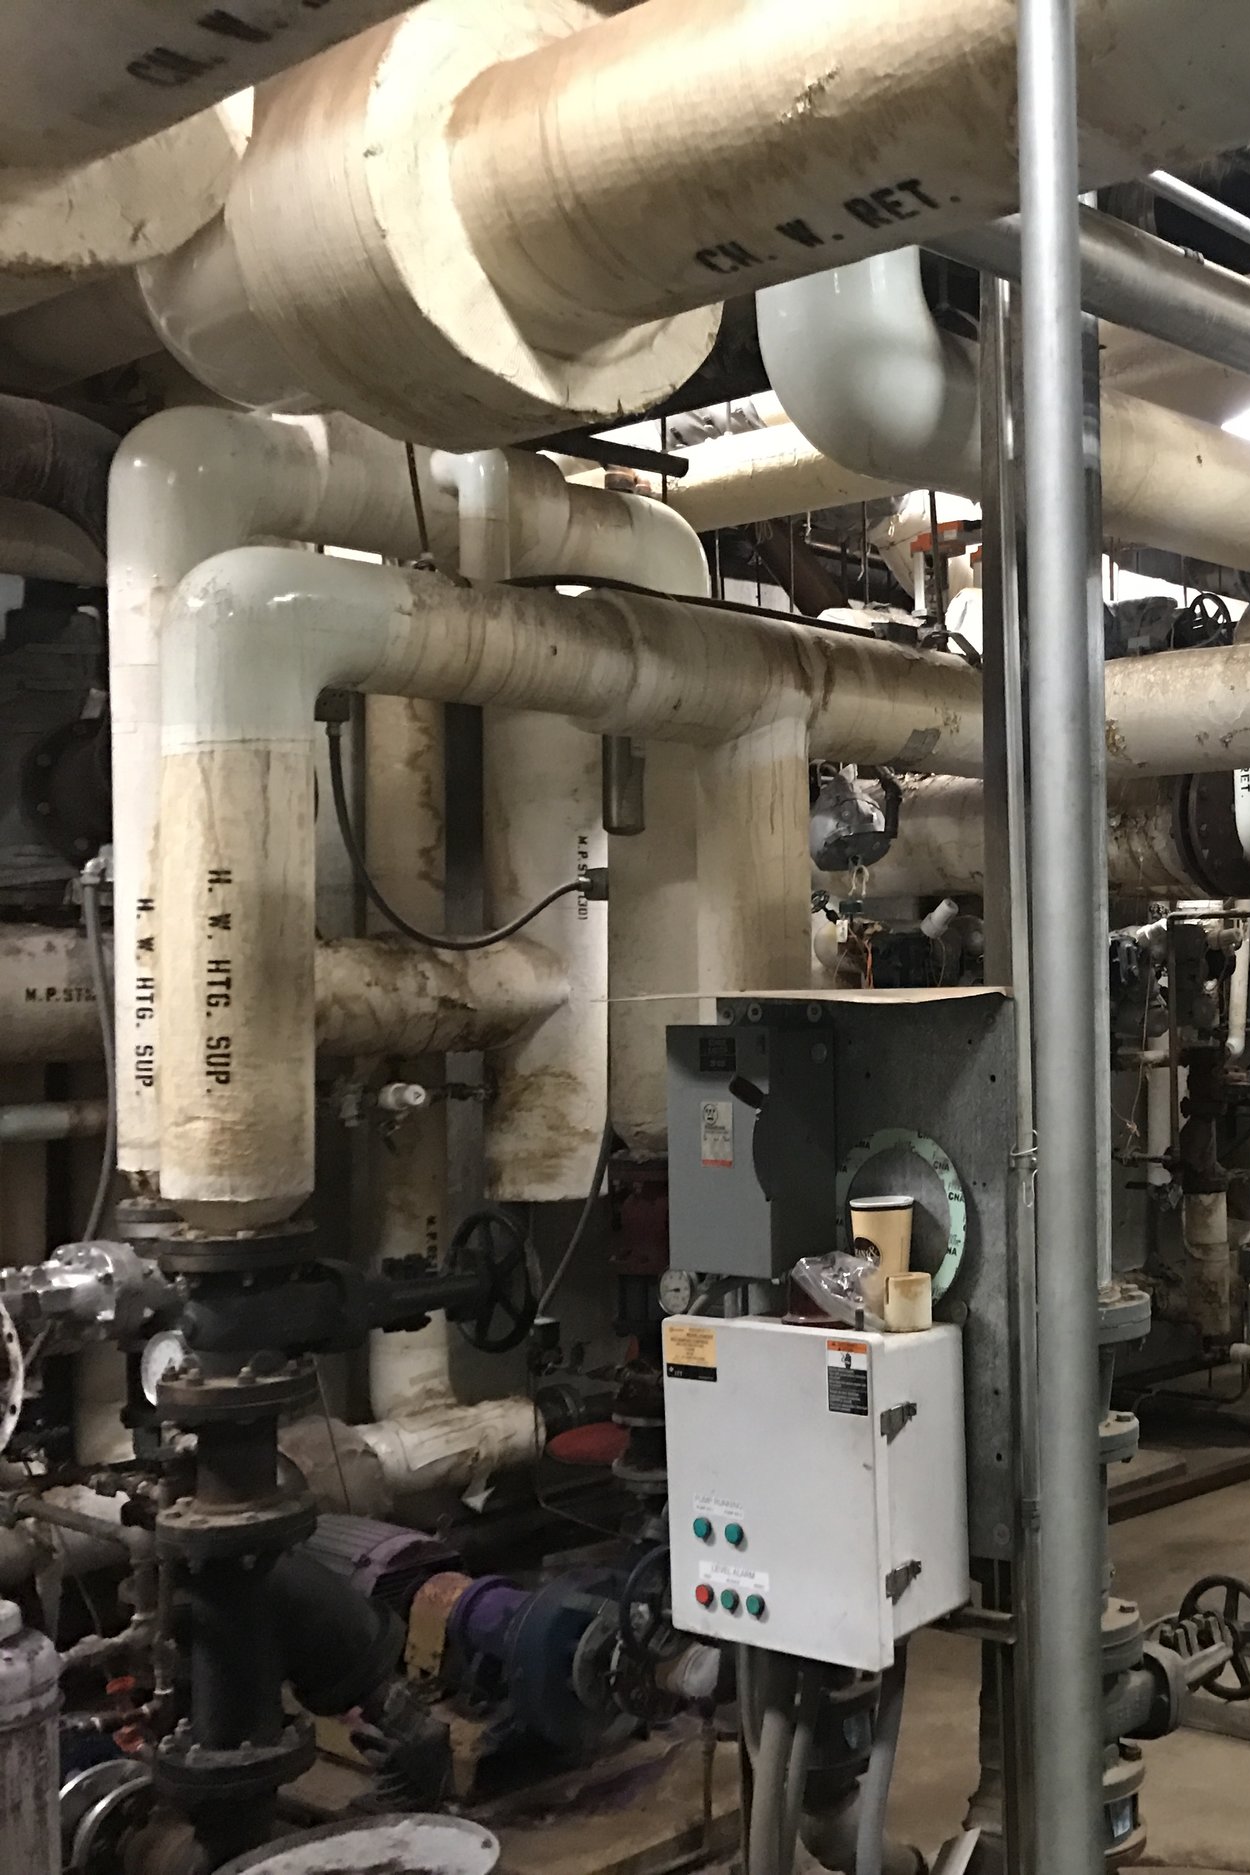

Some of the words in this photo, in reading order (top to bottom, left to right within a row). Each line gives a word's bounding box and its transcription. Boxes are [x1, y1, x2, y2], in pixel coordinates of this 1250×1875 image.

[695, 241, 778, 274] CH.
[774, 218, 844, 247] W.
[843, 178, 961, 228] RET.
[208, 870, 232, 893] H.
[136, 899, 155, 919] H.
[207, 913, 232, 939] W.
[136, 937, 155, 960] W.
[136, 977, 154, 1028] HTG.
[206, 960, 232, 1017] HTG.
[135, 1045, 154, 1096] SUP.
[206, 1036, 232, 1093] SUP.
